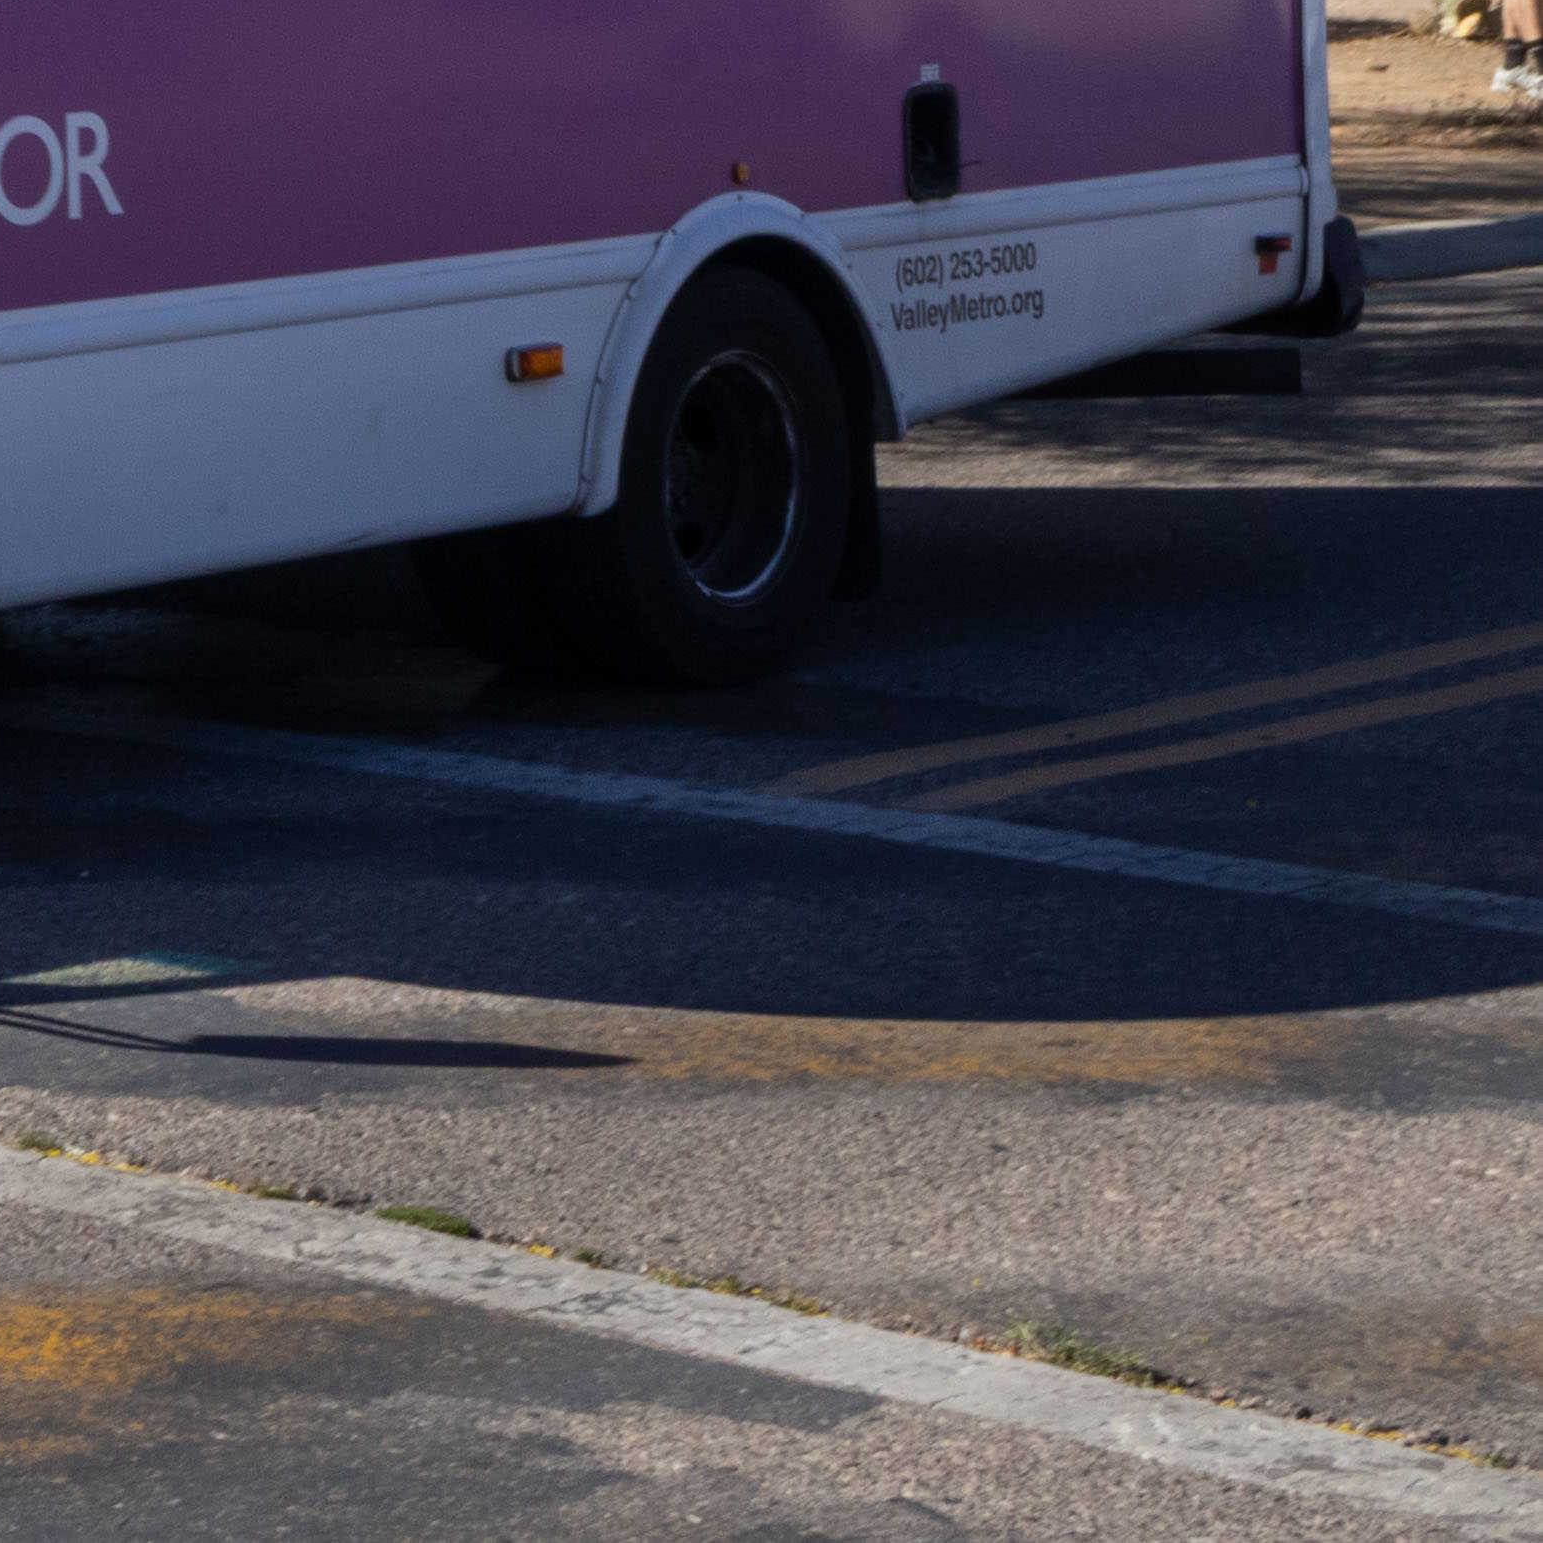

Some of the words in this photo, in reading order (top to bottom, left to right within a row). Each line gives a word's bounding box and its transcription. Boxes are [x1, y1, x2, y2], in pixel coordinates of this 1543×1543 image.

[895, 253, 944, 293] (602)
[949, 241, 1037, 280] 253-5000
[889, 288, 1044, 333] ValleyMetro.org
